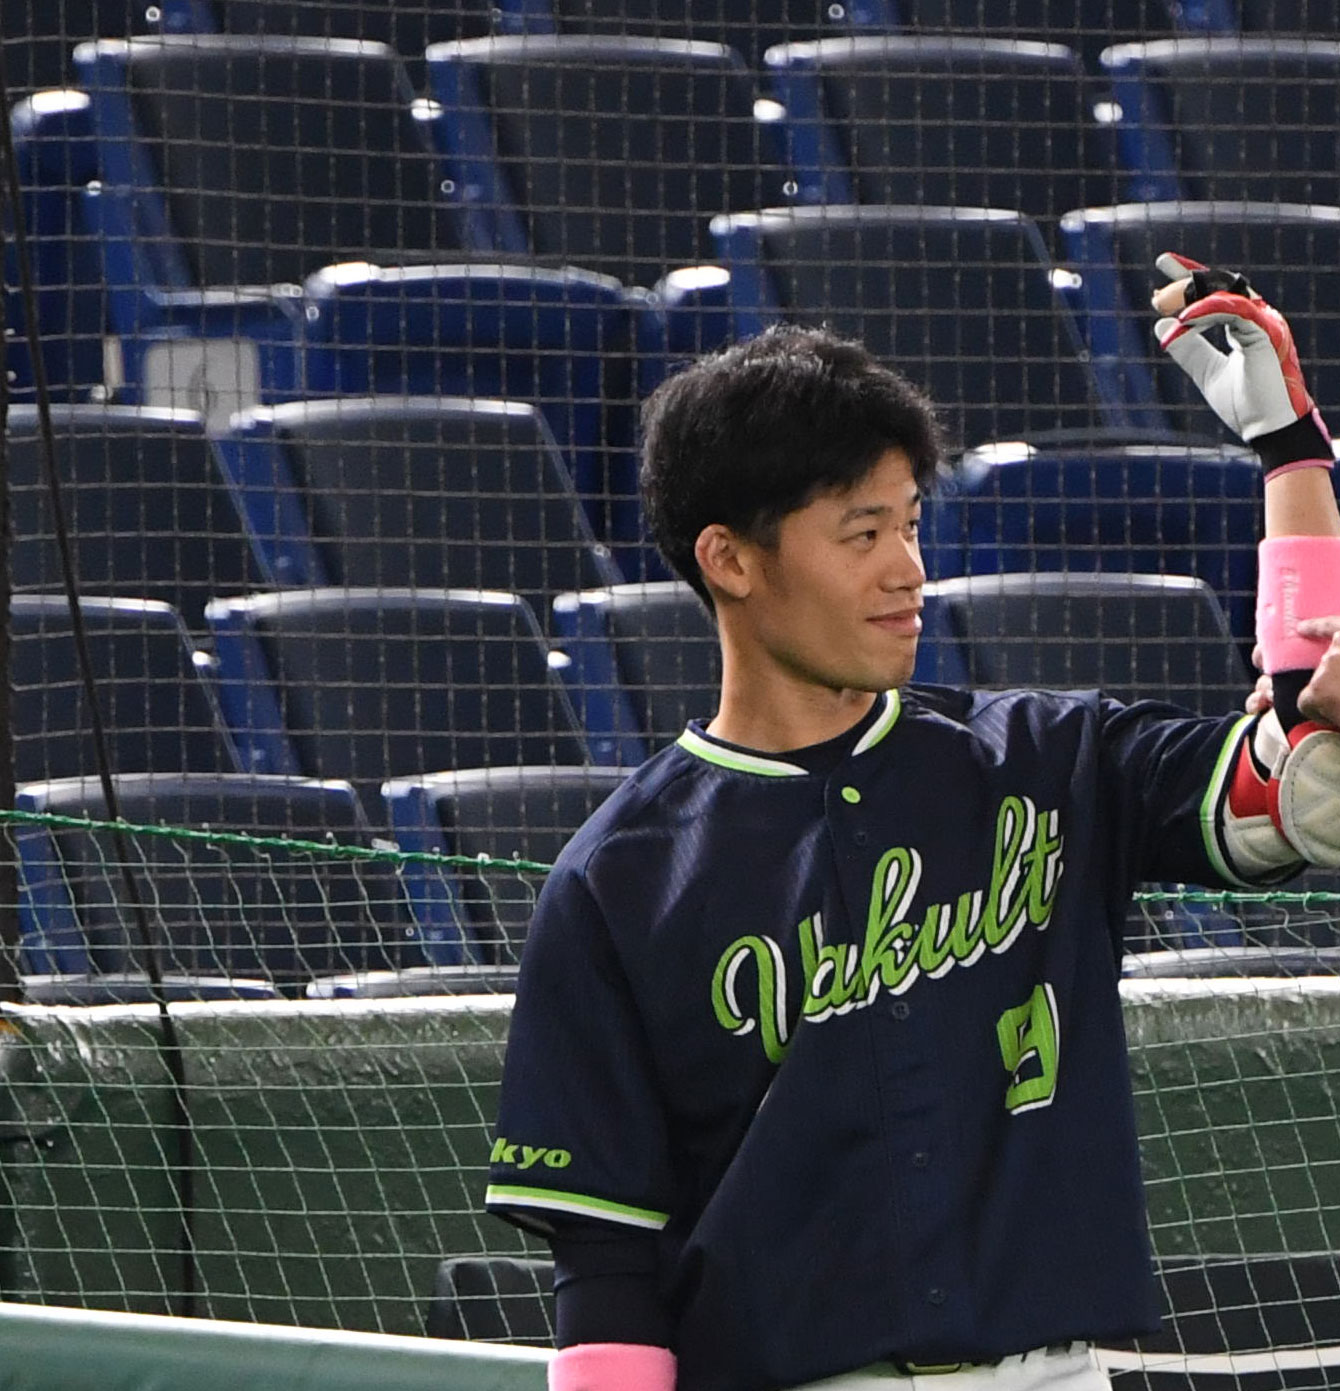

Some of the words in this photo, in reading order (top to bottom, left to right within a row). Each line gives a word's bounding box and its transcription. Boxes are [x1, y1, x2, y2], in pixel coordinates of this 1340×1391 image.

[711, 796, 1064, 1063] Yakult
[997, 982, 1062, 1116] 9
[490, 1137, 572, 1170] kyo
